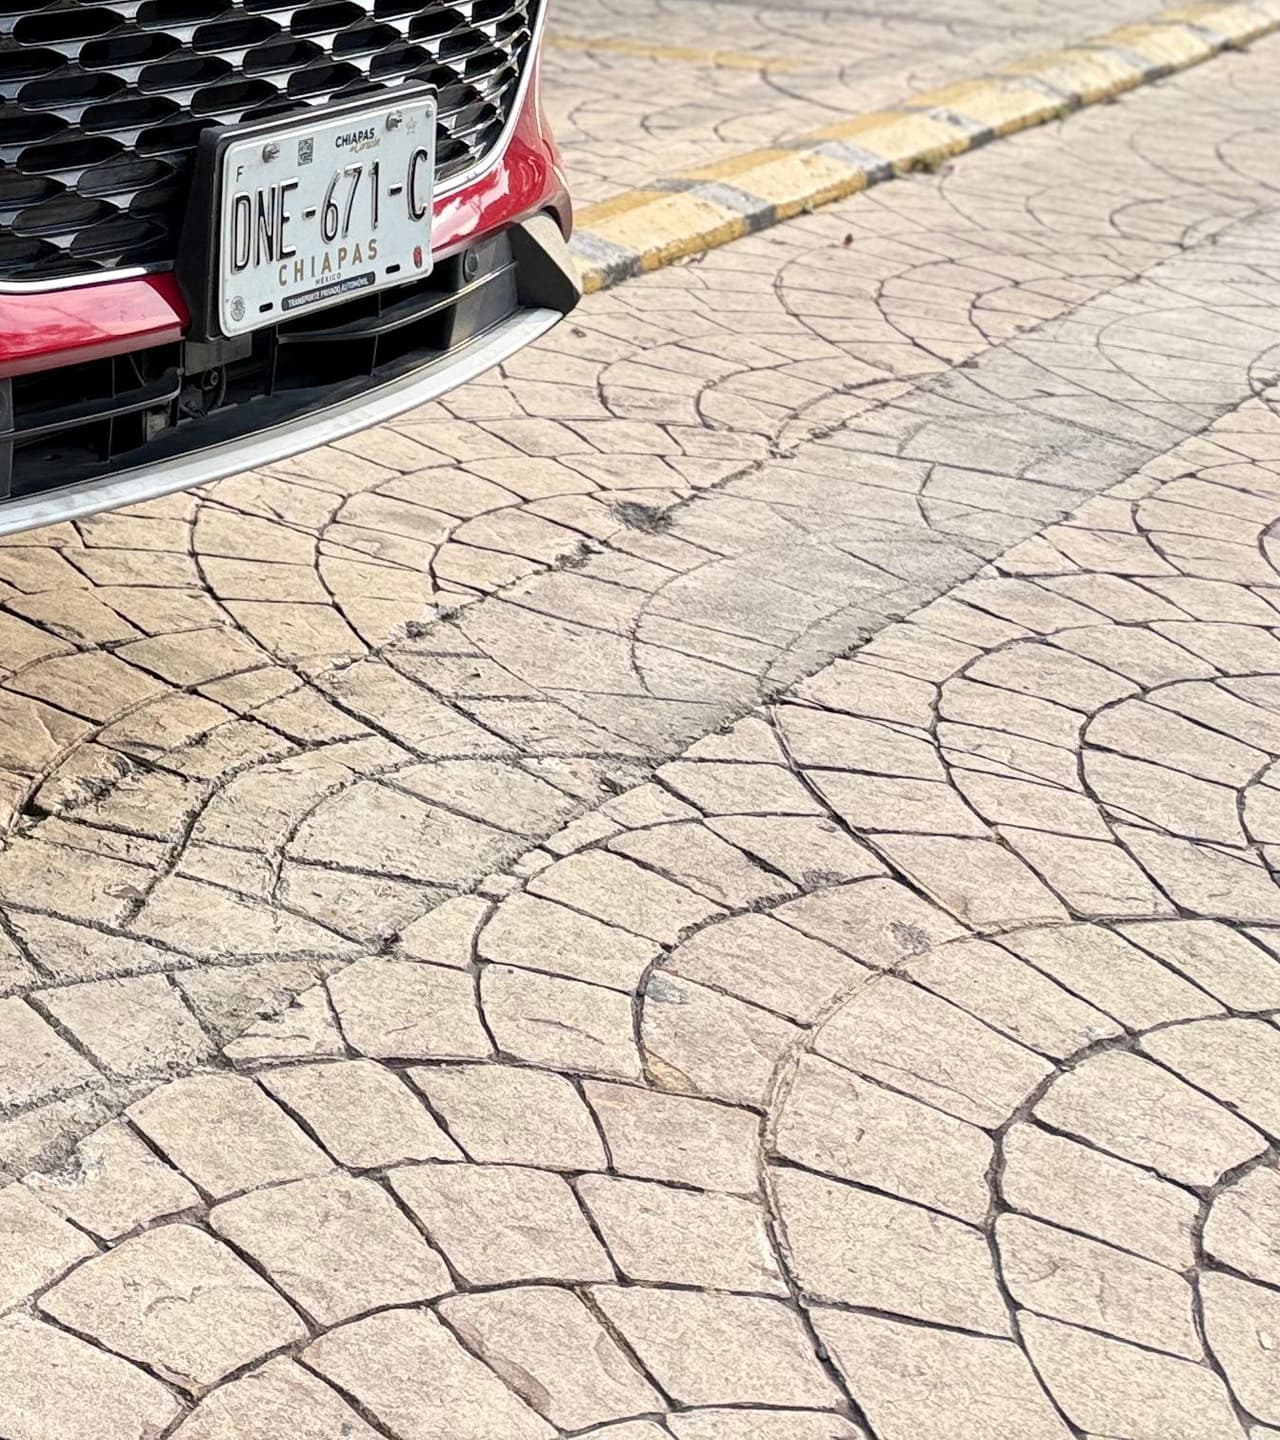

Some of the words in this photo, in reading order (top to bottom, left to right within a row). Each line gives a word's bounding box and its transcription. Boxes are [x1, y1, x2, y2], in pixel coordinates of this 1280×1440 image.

[335, 127, 375, 148] CHIAPAS
[236, 166, 245, 182] F
[231, 146, 428, 274] DNE-671-C
[279, 239, 378, 286] CHIAPAS
[288, 291, 319, 308] TRANSPORTE
[320, 284, 341, 298] PRIVADO
